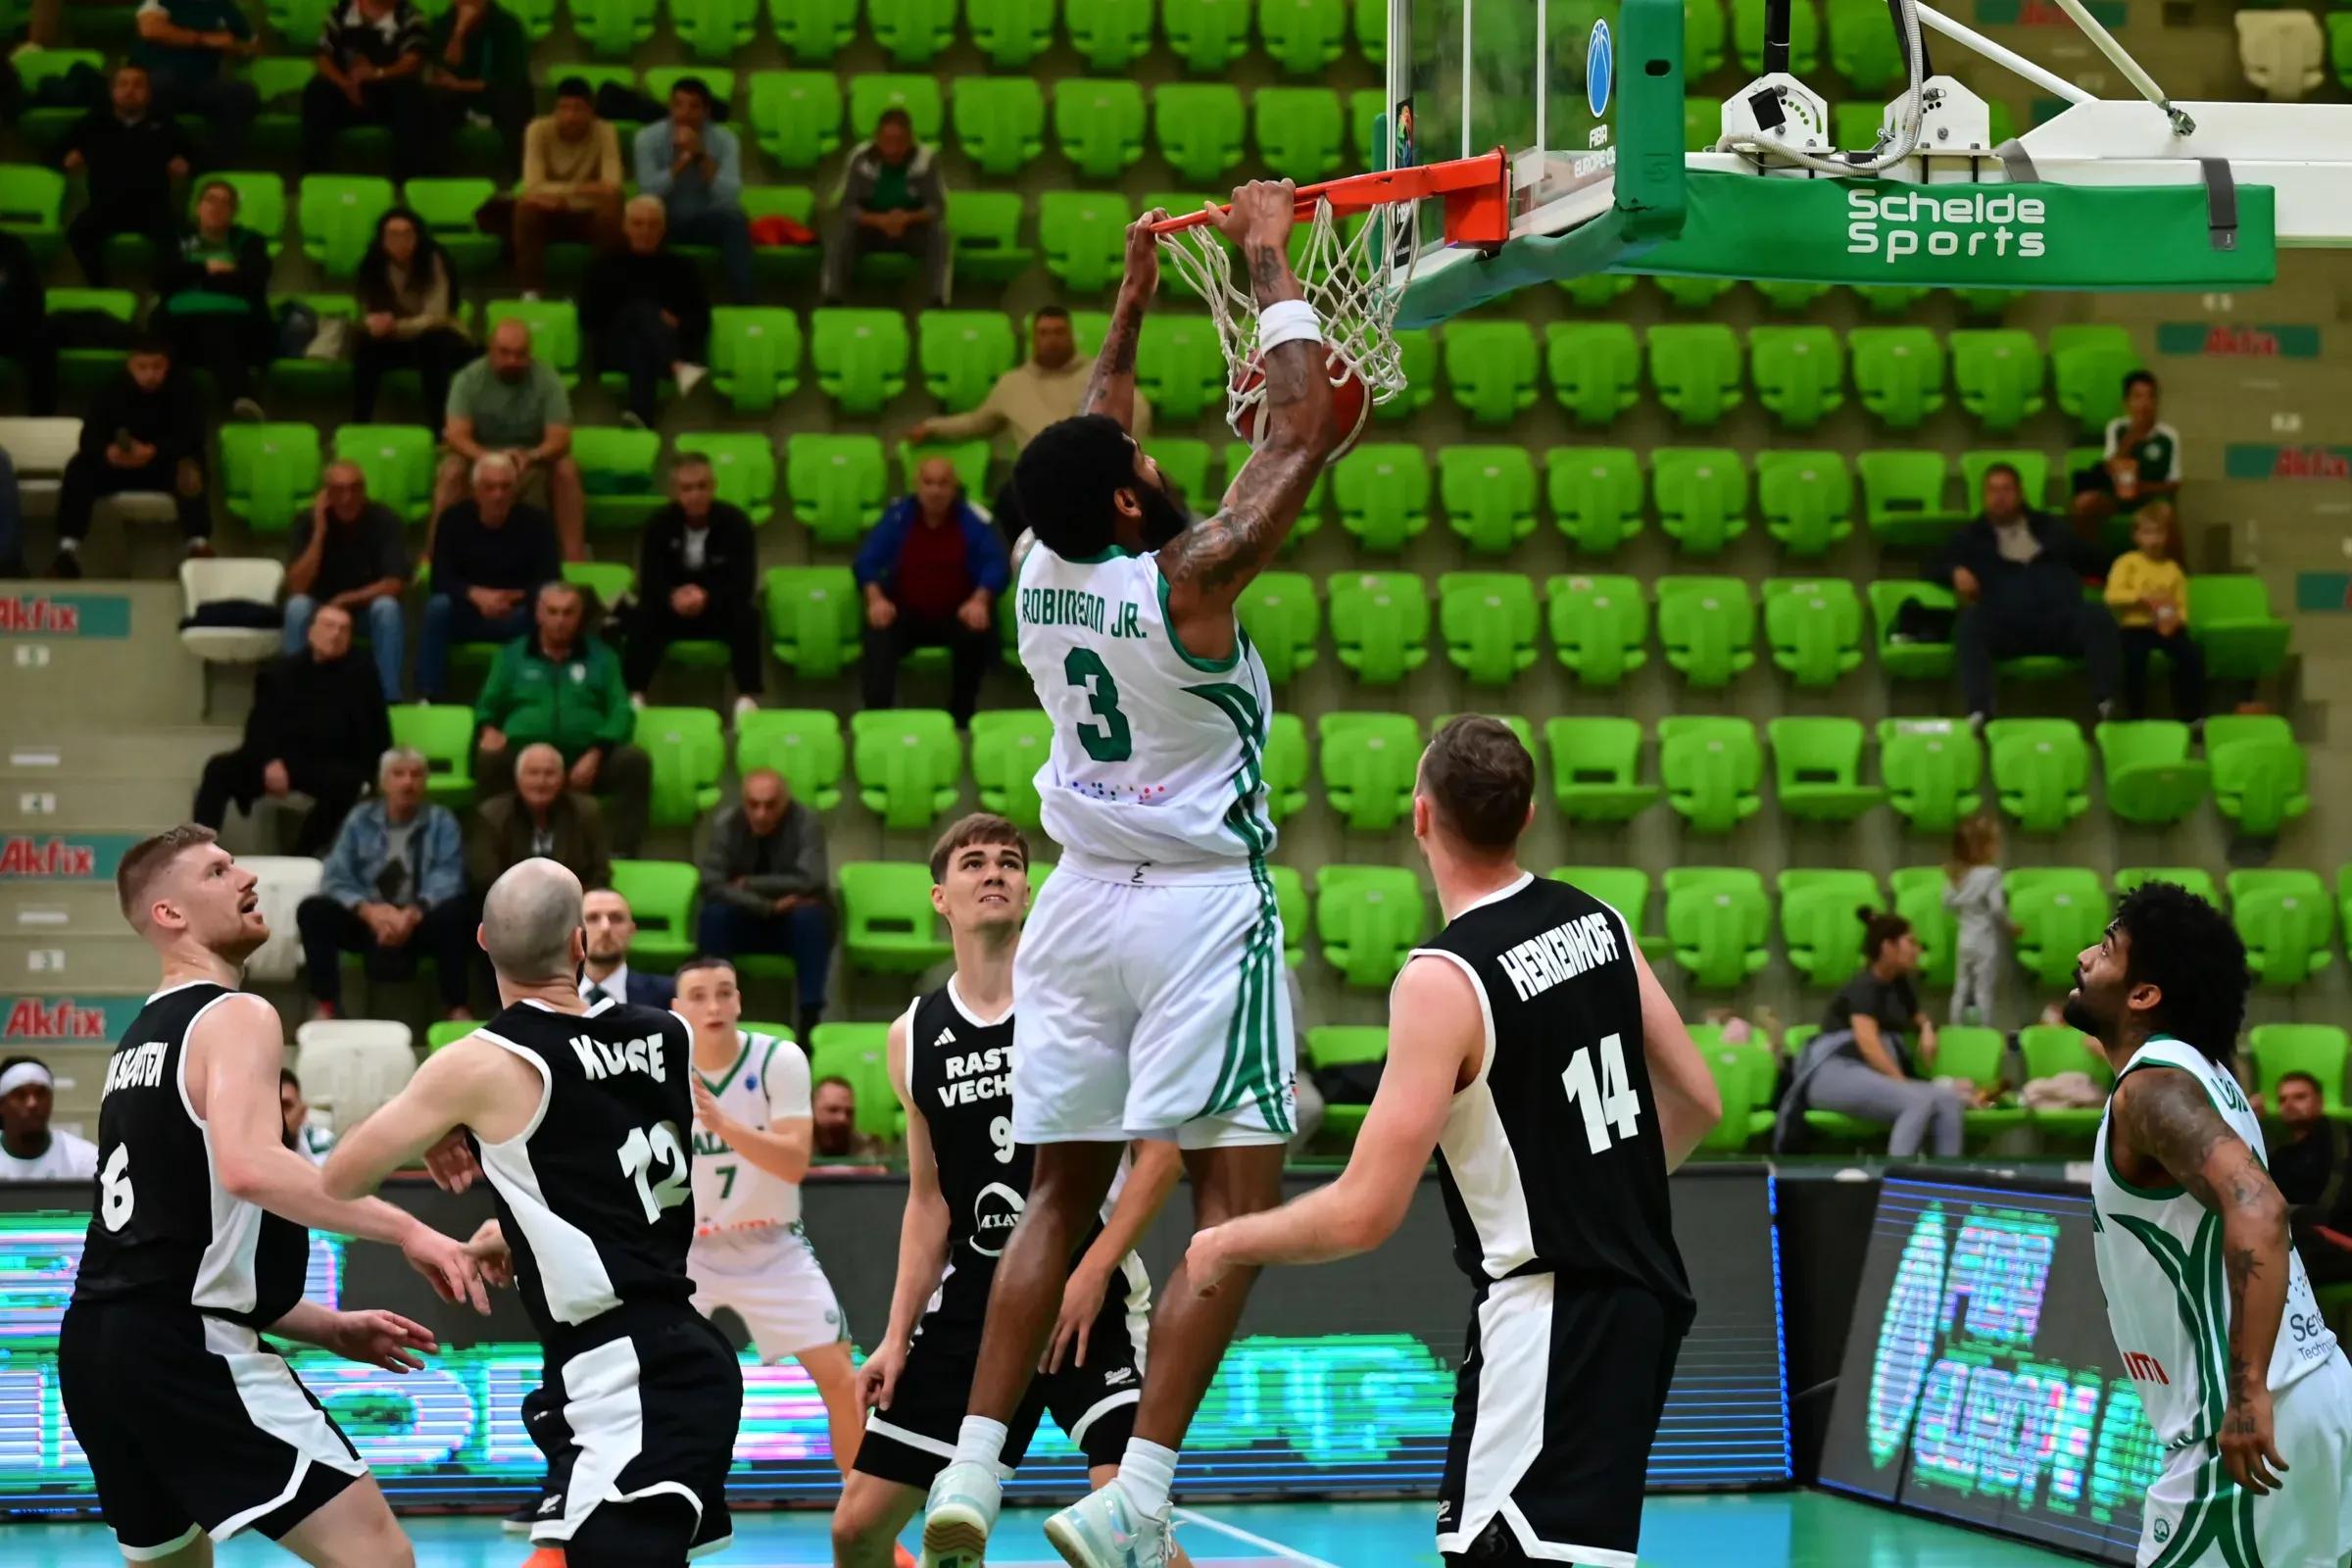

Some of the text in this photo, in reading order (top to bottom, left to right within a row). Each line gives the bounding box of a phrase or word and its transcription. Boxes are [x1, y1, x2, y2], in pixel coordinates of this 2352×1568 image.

[1589, 123, 1608, 149] FIBA
[1847, 188, 2045, 223] Schelde
[1846, 221, 2045, 264] Sports
[1022, 588, 1147, 638] ROBINSON JR.
[1064, 647, 1132, 761] 3
[1, 837, 93, 875] Akfix
[1496, 912, 1619, 1002] HERKENHOFF
[7, 999, 104, 1037] Akfix
[1561, 1032, 1641, 1154] 14
[990, 1115, 1015, 1164] 9
[100, 1142, 134, 1230] 6
[617, 1119, 691, 1224] 12
[715, 1165, 737, 1199] 7
